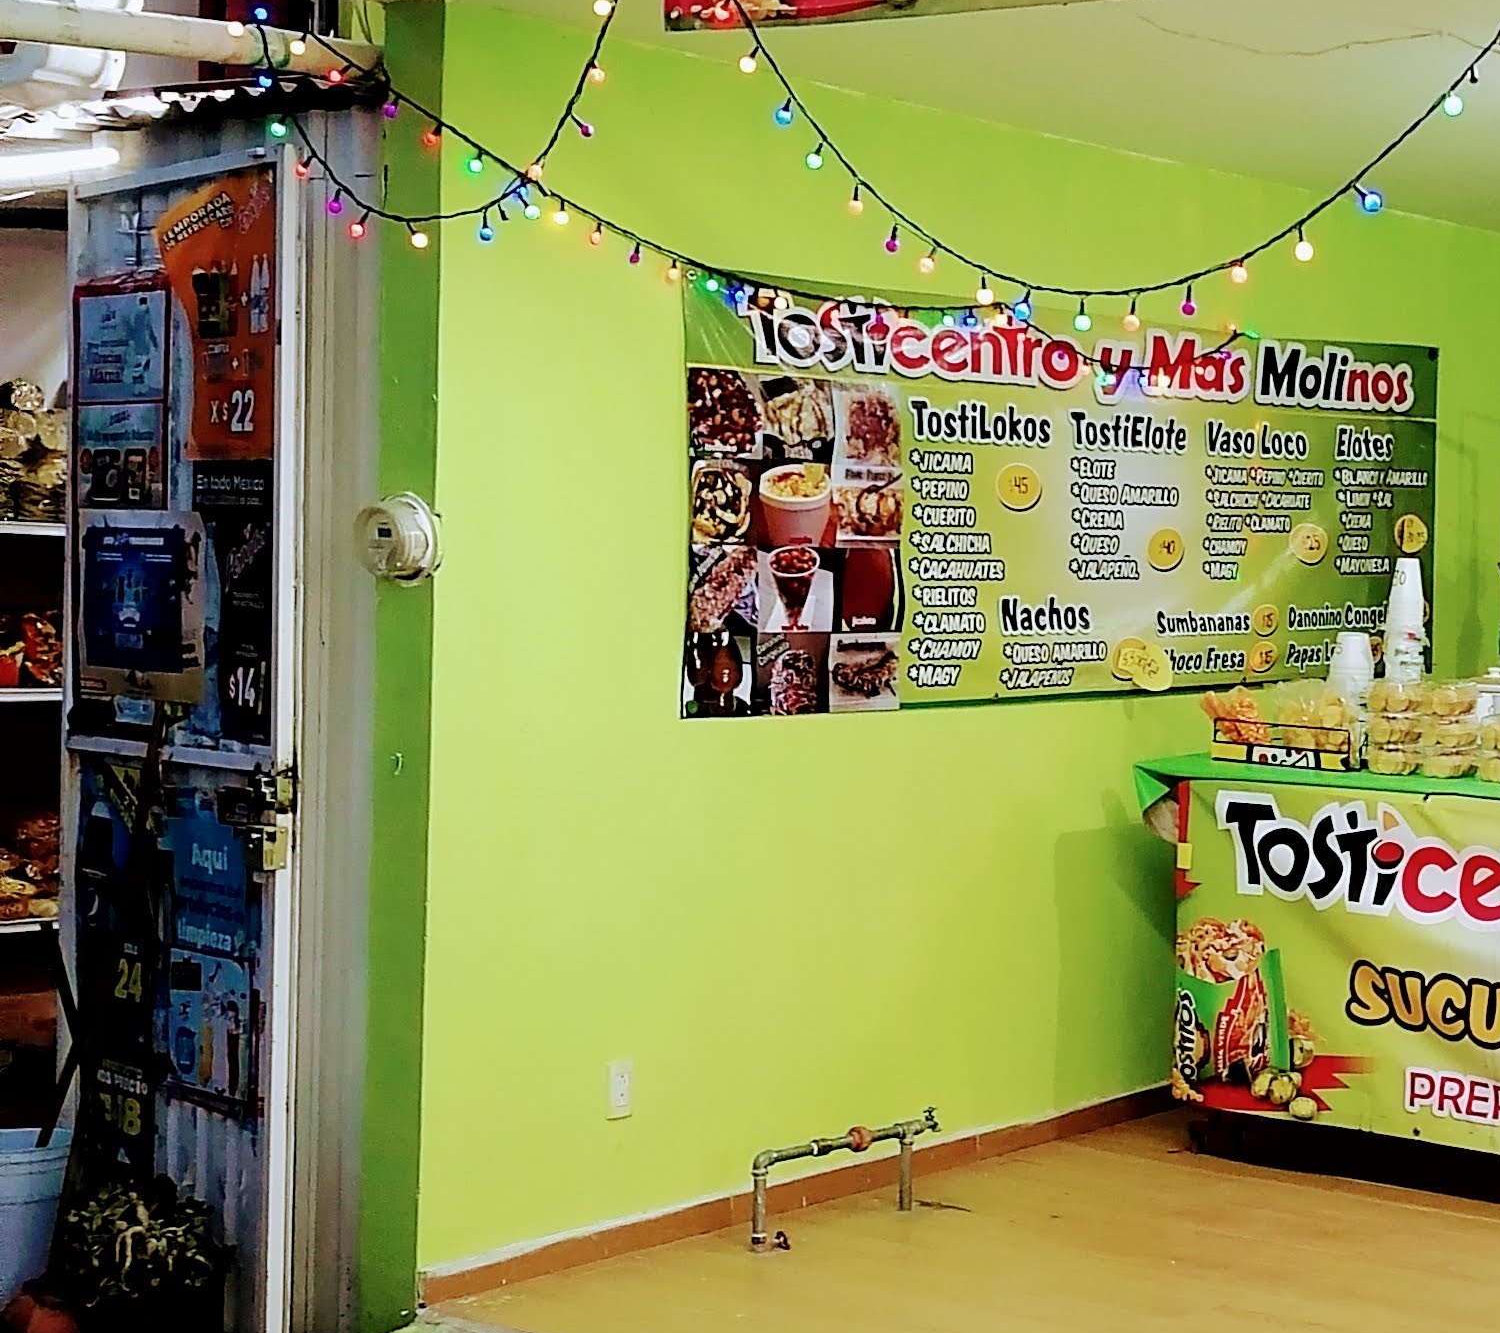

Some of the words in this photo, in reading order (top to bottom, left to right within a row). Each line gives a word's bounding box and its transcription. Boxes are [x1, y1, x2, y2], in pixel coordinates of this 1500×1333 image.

[1261, 346, 1409, 405] Molinos
[909, 399, 1051, 445] TostiLokos
[1070, 411, 1186, 451] TostiElote
[1208, 421, 1255, 455] Vaso
[1262, 424, 1307, 457] Loco
[1336, 427, 1393, 459] Elotes
[920, 451, 973, 473] JICAMA
[1079, 458, 1115, 479] ELOTE
[921, 478, 969, 500] PEPINO
[1080, 483, 1118, 505] QUESO
[1120, 484, 1179, 506] AMARILLO
[922, 506, 976, 527] CUERITO
[1080, 508, 1124, 530] CREMA
[919, 533, 991, 553] SALCHICHA
[1080, 533, 1120, 554] QUESO
[919, 560, 1004, 580] CACAHUATES
[921, 586, 977, 607] RIELITOS
[923, 612, 985, 633] CLAMATO
[1001, 596, 1090, 634] Nachos
[1157, 610, 1250, 634] Sumbananas
[1288, 605, 1342, 629] Danonino
[1345, 601, 1388, 631] Congel
[919, 639, 981, 659] CHAMOY
[1012, 643, 1049, 663] QUESO
[1052, 641, 1108, 662] AMARILLO
[1165, 649, 1202, 672] hoco
[1206, 647, 1245, 670] Fresa
[1286, 643, 1321, 672] Papas
[918, 665, 961, 686] MAGY
[115, 959, 142, 1003] 24
